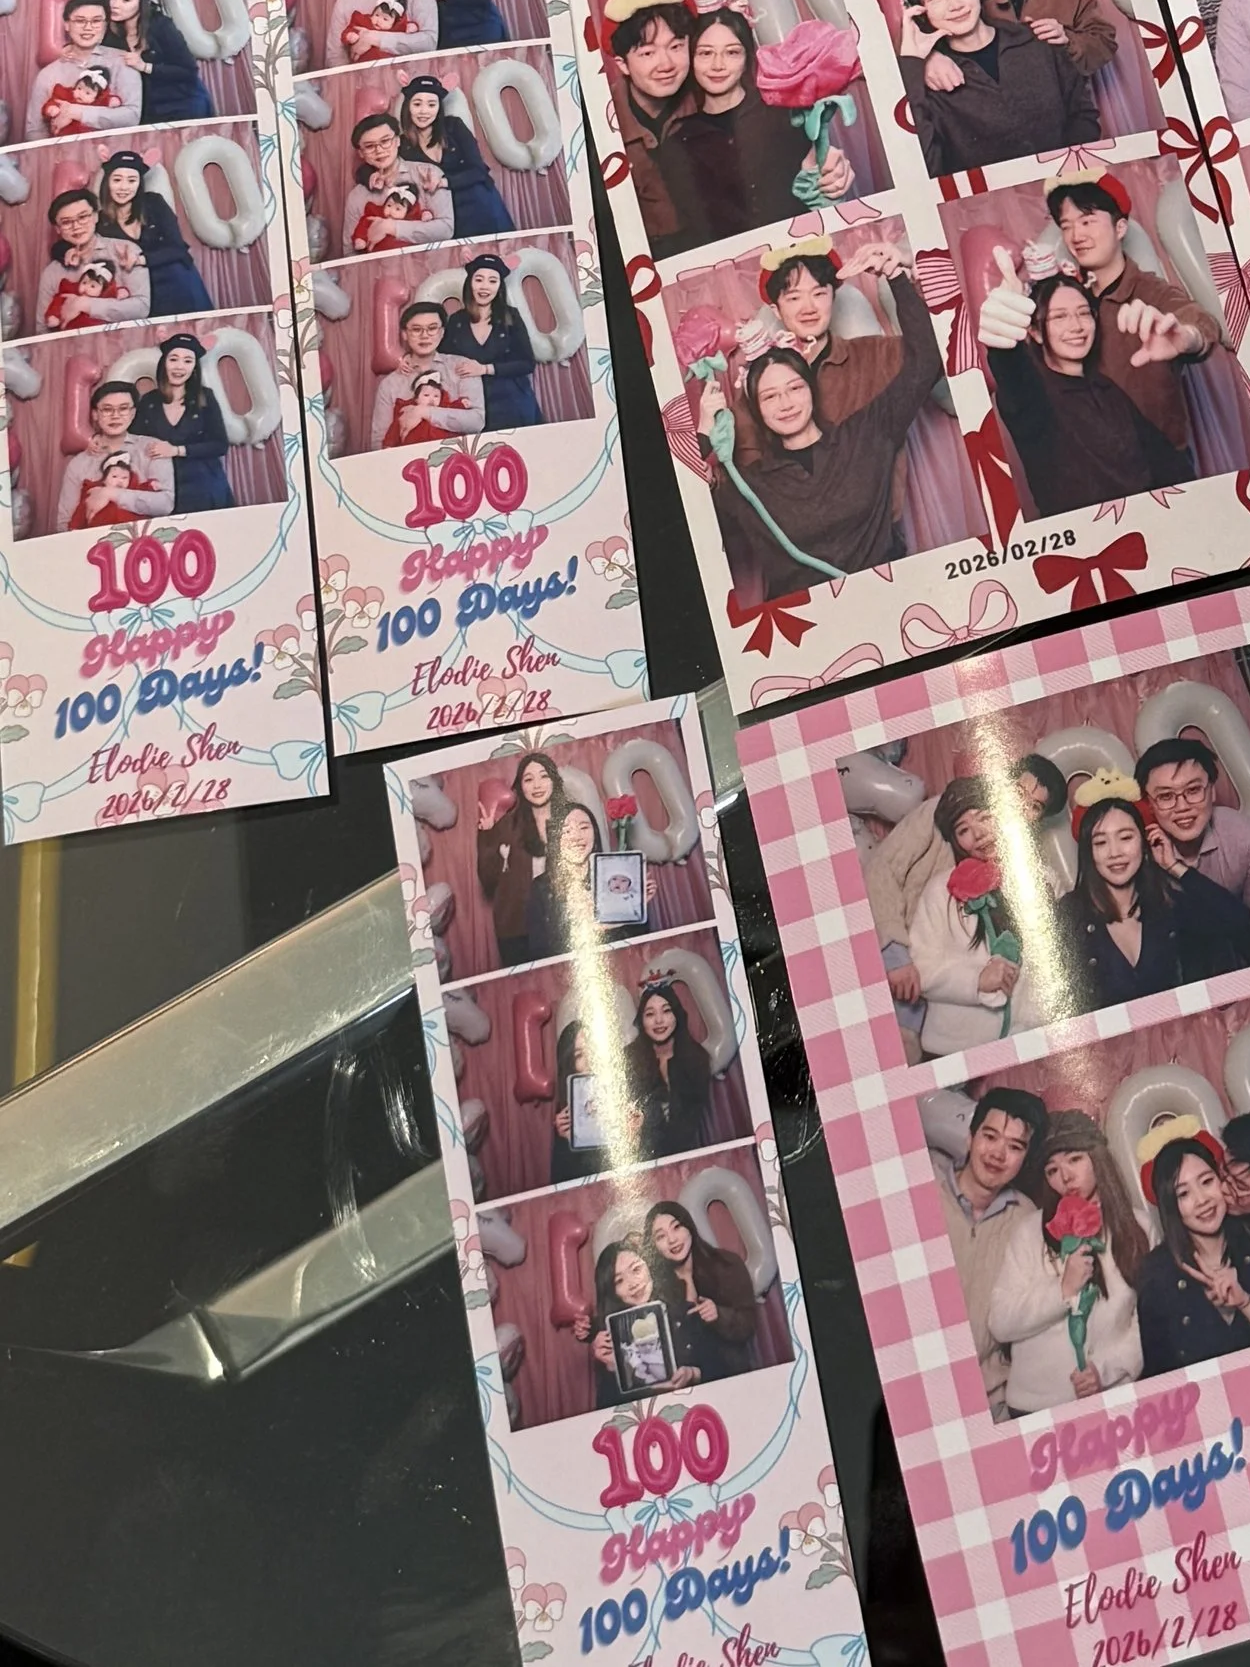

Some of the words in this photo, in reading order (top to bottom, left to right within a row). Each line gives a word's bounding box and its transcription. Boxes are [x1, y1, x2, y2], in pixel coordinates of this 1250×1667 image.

[402, 444, 528, 528] 100
[87, 529, 216, 613] 100
[399, 524, 549, 594] Happy
[945, 529, 1077, 580] 2026/02/28
[79, 610, 235, 679] Happy
[376, 598, 441, 653] 100
[456, 555, 578, 629] Days!
[54, 683, 121, 739] 100
[137, 642, 264, 715] Days!
[410, 655, 493, 696] Elodie
[501, 635, 561, 680] Shen
[426, 689, 552, 731] 2026/2/28
[87, 743, 173, 784] Elodie
[181, 723, 243, 768] Shen
[103, 777, 232, 819] 2026/2/28
[592, 1402, 729, 1509] 100
[1029, 1381, 1201, 1492] Happy
[1009, 1494, 1087, 1575] 100
[1104, 1416, 1247, 1532] Days!
[598, 1492, 756, 1586] Happy
[1065, 1566, 1162, 1628] Elodie
[1173, 1531, 1243, 1595] Shen
[578, 1588, 648, 1656] 100
[663, 1525, 792, 1621] Days!
[1092, 1601, 1238, 1667] 2026/2/28
